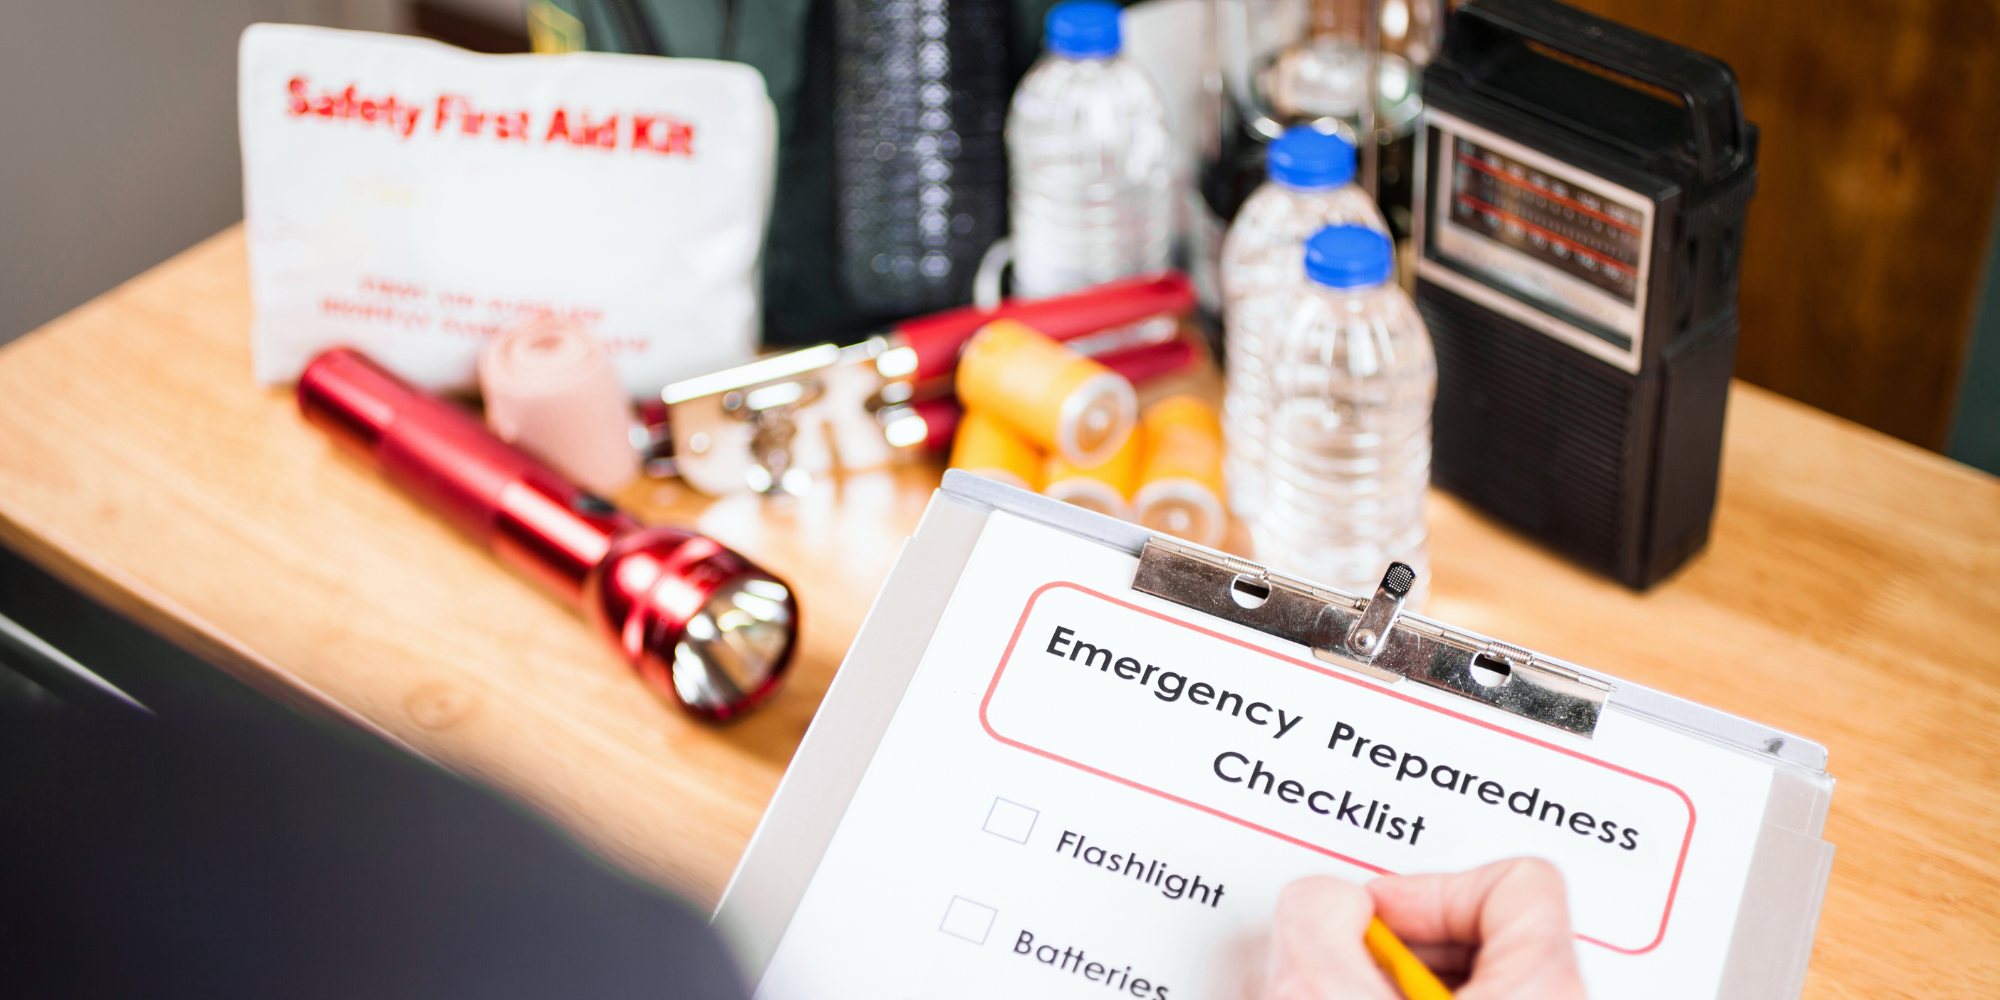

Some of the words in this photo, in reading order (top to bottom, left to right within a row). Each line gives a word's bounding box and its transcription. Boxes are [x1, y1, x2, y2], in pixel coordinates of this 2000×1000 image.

[286, 75, 422, 140] Safety
[433, 94, 531, 143] First
[543, 106, 620, 153] Aid
[629, 113, 696, 159] Kit
[1045, 625, 1304, 739] Emergency
[1327, 721, 1640, 851] Preparedness
[1213, 751, 1427, 846] Checklist
[1055, 829, 1226, 909] Flashlight
[1012, 929, 1171, 1000] Batteries
